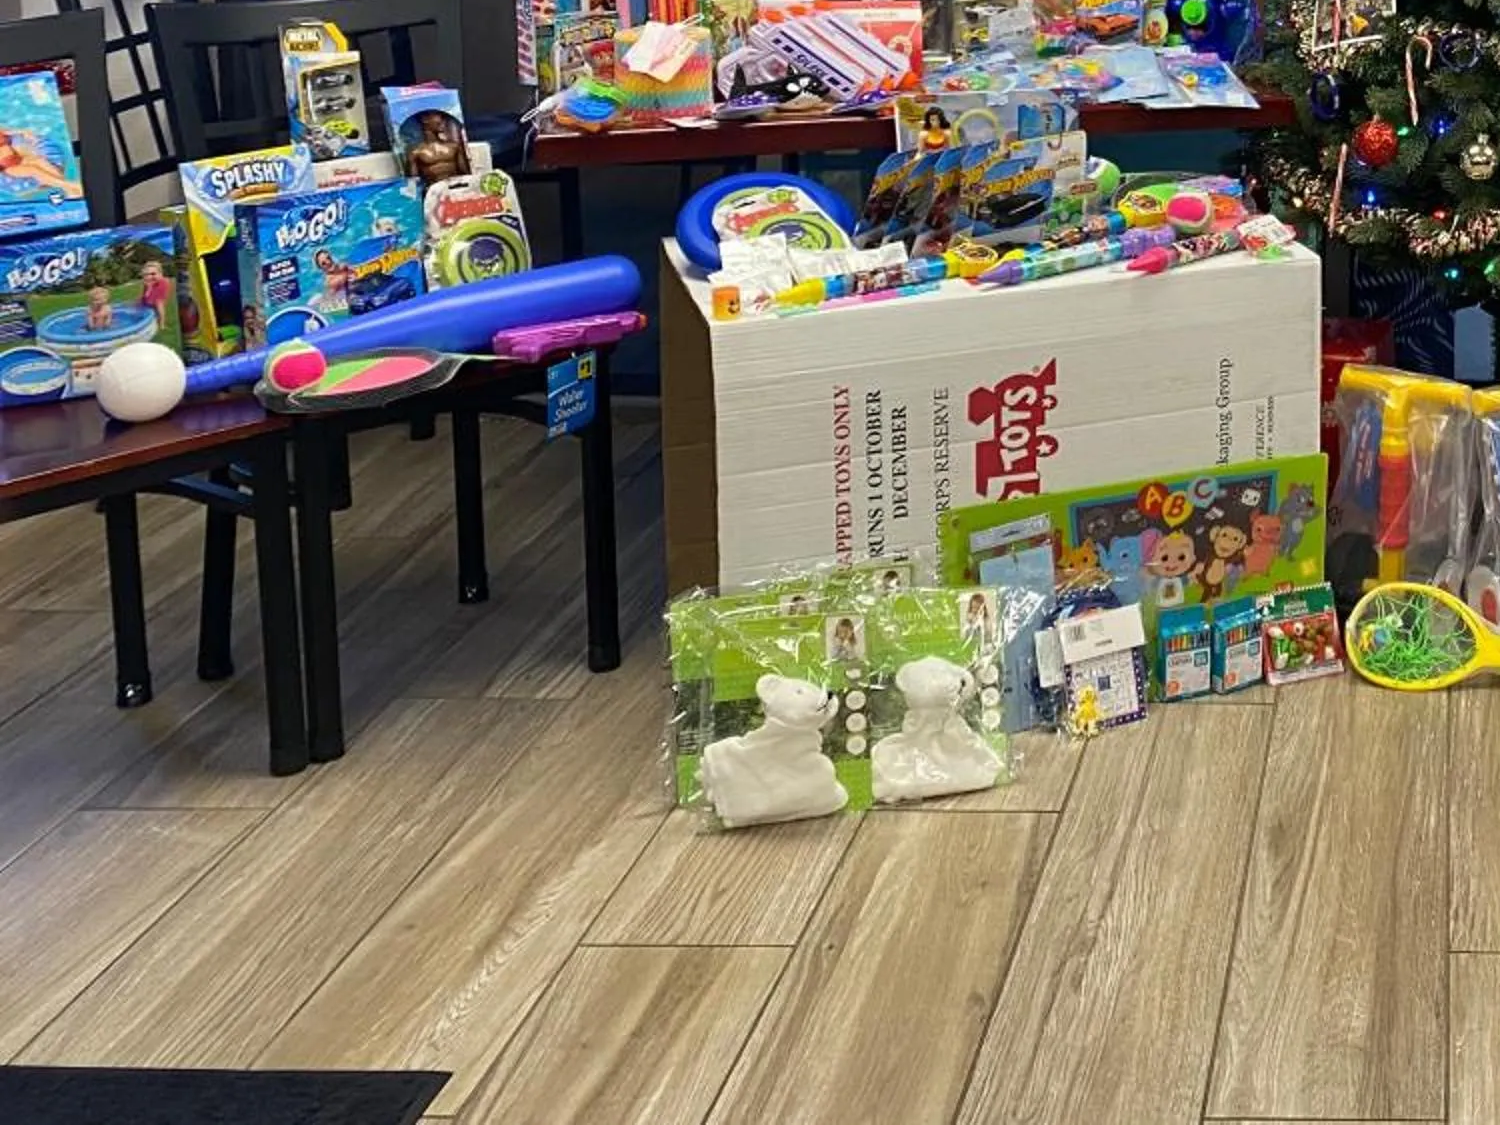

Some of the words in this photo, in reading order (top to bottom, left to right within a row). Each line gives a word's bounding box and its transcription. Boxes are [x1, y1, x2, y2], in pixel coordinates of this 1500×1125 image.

[211, 160, 286, 197] SPLASHY
[1215, 358, 1233, 409] Group
[833, 385, 851, 437] ONLY
[933, 386, 950, 476] RESERVE
[1001, 386, 1038, 473] TOTS
[866, 389, 883, 489] OCTOBER
[891, 405, 910, 520] DECEMBER
[1217, 411, 1233, 468] kaging
[834, 443, 851, 495] TOYS
[868, 493, 883, 503] 1
[1145, 487, 1162, 511] A
[1167, 495, 1185, 517] B
[1193, 480, 1211, 498] C
[867, 506, 885, 559] RUNS
